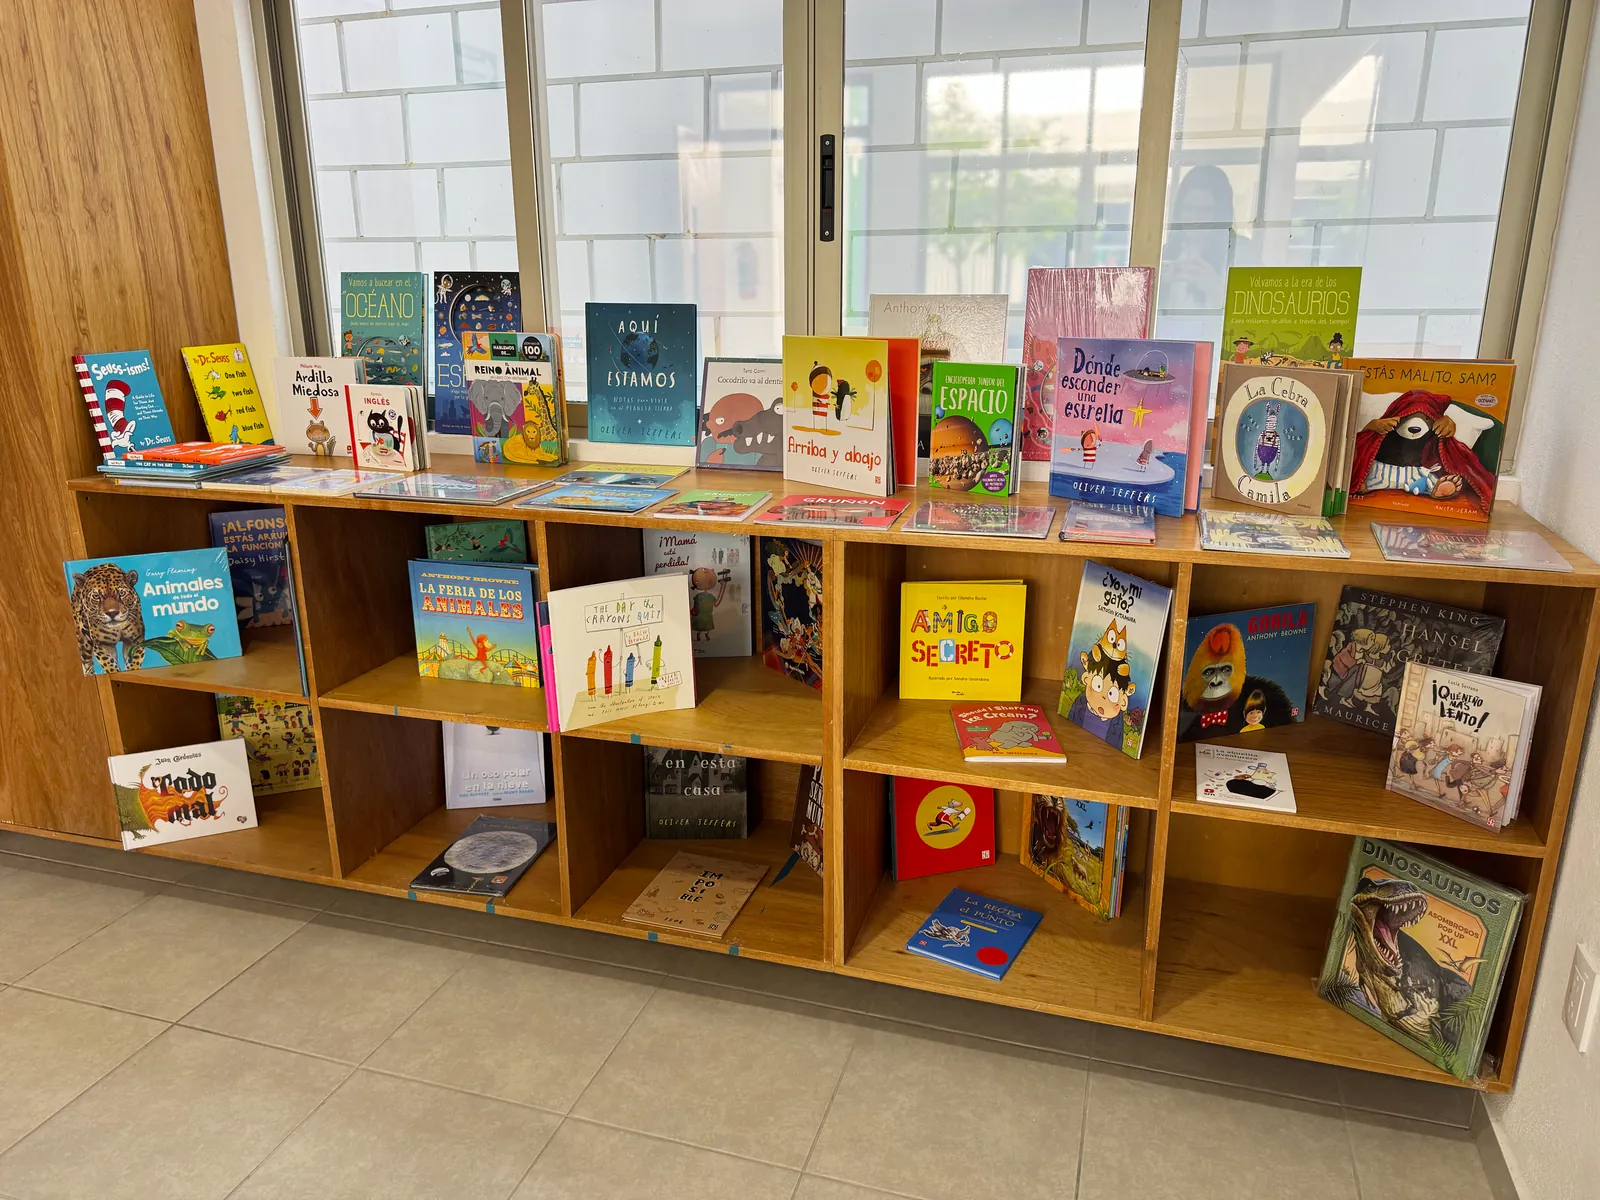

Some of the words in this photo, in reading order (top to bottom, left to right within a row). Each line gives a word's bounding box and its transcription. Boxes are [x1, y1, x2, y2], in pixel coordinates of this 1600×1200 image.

[349, 278, 367, 287] Vamos
[375, 278, 393, 287] bucear
[1250, 276, 1282, 288] Volvamos
[1284, 278, 1289, 287] a
[1292, 276, 1299, 288] la
[1301, 278, 1313, 288] era
[1315, 276, 1323, 288] de
[1326, 276, 1337, 288] los
[345, 289, 414, 319] OCÉANO
[883, 301, 931, 314] Anthony
[1233, 290, 1350, 315] DINOSAURIOS
[618, 314, 659, 334] AQUÍ
[524, 346, 540, 355] 100
[198, 355, 211, 366] Dr.
[210, 352, 230, 363] Seuss
[1073, 347, 1121, 378] Dónde
[91, 357, 150, 381] Seuss-isms!
[236, 370, 247, 378] fish
[296, 369, 333, 384] Ardilla
[474, 365, 502, 376] REINO
[505, 367, 541, 377] ANIMAL
[608, 371, 677, 389] ESTAMOS
[717, 376, 748, 384] Cocodrilo
[1400, 369, 1453, 386] MALITO,
[1459, 371, 1497, 386] SAM?
[243, 388, 253, 396] fish
[293, 383, 339, 397] Miedosa
[1061, 375, 1121, 396] esconder
[1244, 384, 1266, 400] La
[1271, 377, 1309, 408] Cebra
[364, 397, 390, 406] INGLÉS
[940, 386, 1008, 415] ESPACIO
[1077, 392, 1097, 403] una
[1064, 401, 1124, 425] estrella
[600, 426, 632, 436] OLIVER
[641, 427, 682, 440] JEFFERS
[145, 438, 155, 446] Dr.
[156, 436, 171, 445] Seuss
[788, 436, 827, 459] Arriba
[831, 450, 839, 464] y
[845, 445, 882, 472] abajo
[811, 467, 830, 475] OLIVER
[832, 468, 857, 480] JEFFERS
[1073, 481, 1106, 495] OLIVER
[1111, 487, 1157, 504] JEFFERS
[1237, 474, 1291, 503] Camila
[1435, 505, 1454, 514] ANITA
[1456, 507, 1478, 515] JERAM
[224, 531, 254, 544] ESTÁS
[659, 534, 697, 548] ¡Mamá
[226, 545, 238, 553] LA
[229, 557, 255, 567] Daisy
[258, 552, 285, 563] Hirst
[655, 556, 690, 572] perdida!
[145, 568, 165, 578] Garry
[167, 567, 197, 576] Fleming
[421, 572, 472, 580] ANTHONY
[473, 577, 519, 585] BROWNE
[143, 577, 224, 598] Animales
[419, 582, 436, 595] LA
[438, 584, 476, 598] FERIA
[480, 588, 496, 600] DE
[499, 589, 522, 602] LOS
[1102, 572, 1121, 592] ¿Yo
[1120, 584, 1129, 598] y
[1129, 582, 1143, 599] mi
[152, 596, 219, 617] mundo
[422, 595, 525, 620] ANIMALES
[594, 605, 608, 614] THE
[616, 601, 635, 613] DAY
[643, 599, 655, 609] the
[1104, 590, 1135, 613] gato?
[1360, 592, 1430, 615] STEPHEN
[1438, 609, 1480, 626] KING
[586, 614, 630, 625] CRAYONS
[637, 610, 661, 624] QUIT
[911, 609, 997, 633] AMIGO
[1115, 611, 1137, 624] KITAMURA
[1247, 609, 1308, 634] GORILA
[1247, 632, 1277, 642] ANTHONY
[1281, 628, 1308, 637] BROWNE
[1401, 623, 1483, 654] HANSEL
[911, 639, 1014, 669] SECRETO
[1449, 700, 1470, 711] MÁS
[958, 708, 987, 719] Should
[962, 715, 983, 724] Ice
[983, 712, 1038, 720] Cream?
[1323, 706, 1389, 731] MAURICE
[1440, 702, 1490, 733] LENTO!
[665, 759, 685, 769] en
[700, 758, 736, 769] esta
[482, 770, 500, 779] oso
[503, 768, 531, 779] polar
[150, 768, 217, 796] Todo
[465, 783, 480, 792] en
[483, 780, 495, 791] la
[497, 780, 529, 791] nieve
[684, 786, 720, 796] casa
[167, 792, 216, 824] mal
[659, 818, 690, 826] OLIVER
[698, 818, 737, 828] JEFFERS
[700, 870, 723, 880] IM
[1362, 839, 1501, 916] DINOSAURIOS
[688, 886, 706, 895] SI
[694, 879, 715, 888] PO
[679, 893, 703, 903] BLE
[964, 897, 978, 906] La
[984, 903, 1023, 920] RECTA
[974, 910, 1015, 927] PUNTO
[1428, 910, 1480, 940] ASOMBROSOS
[1437, 922, 1453, 935] POP
[1453, 930, 1465, 941] UP
[1439, 932, 1458, 949] XXL
